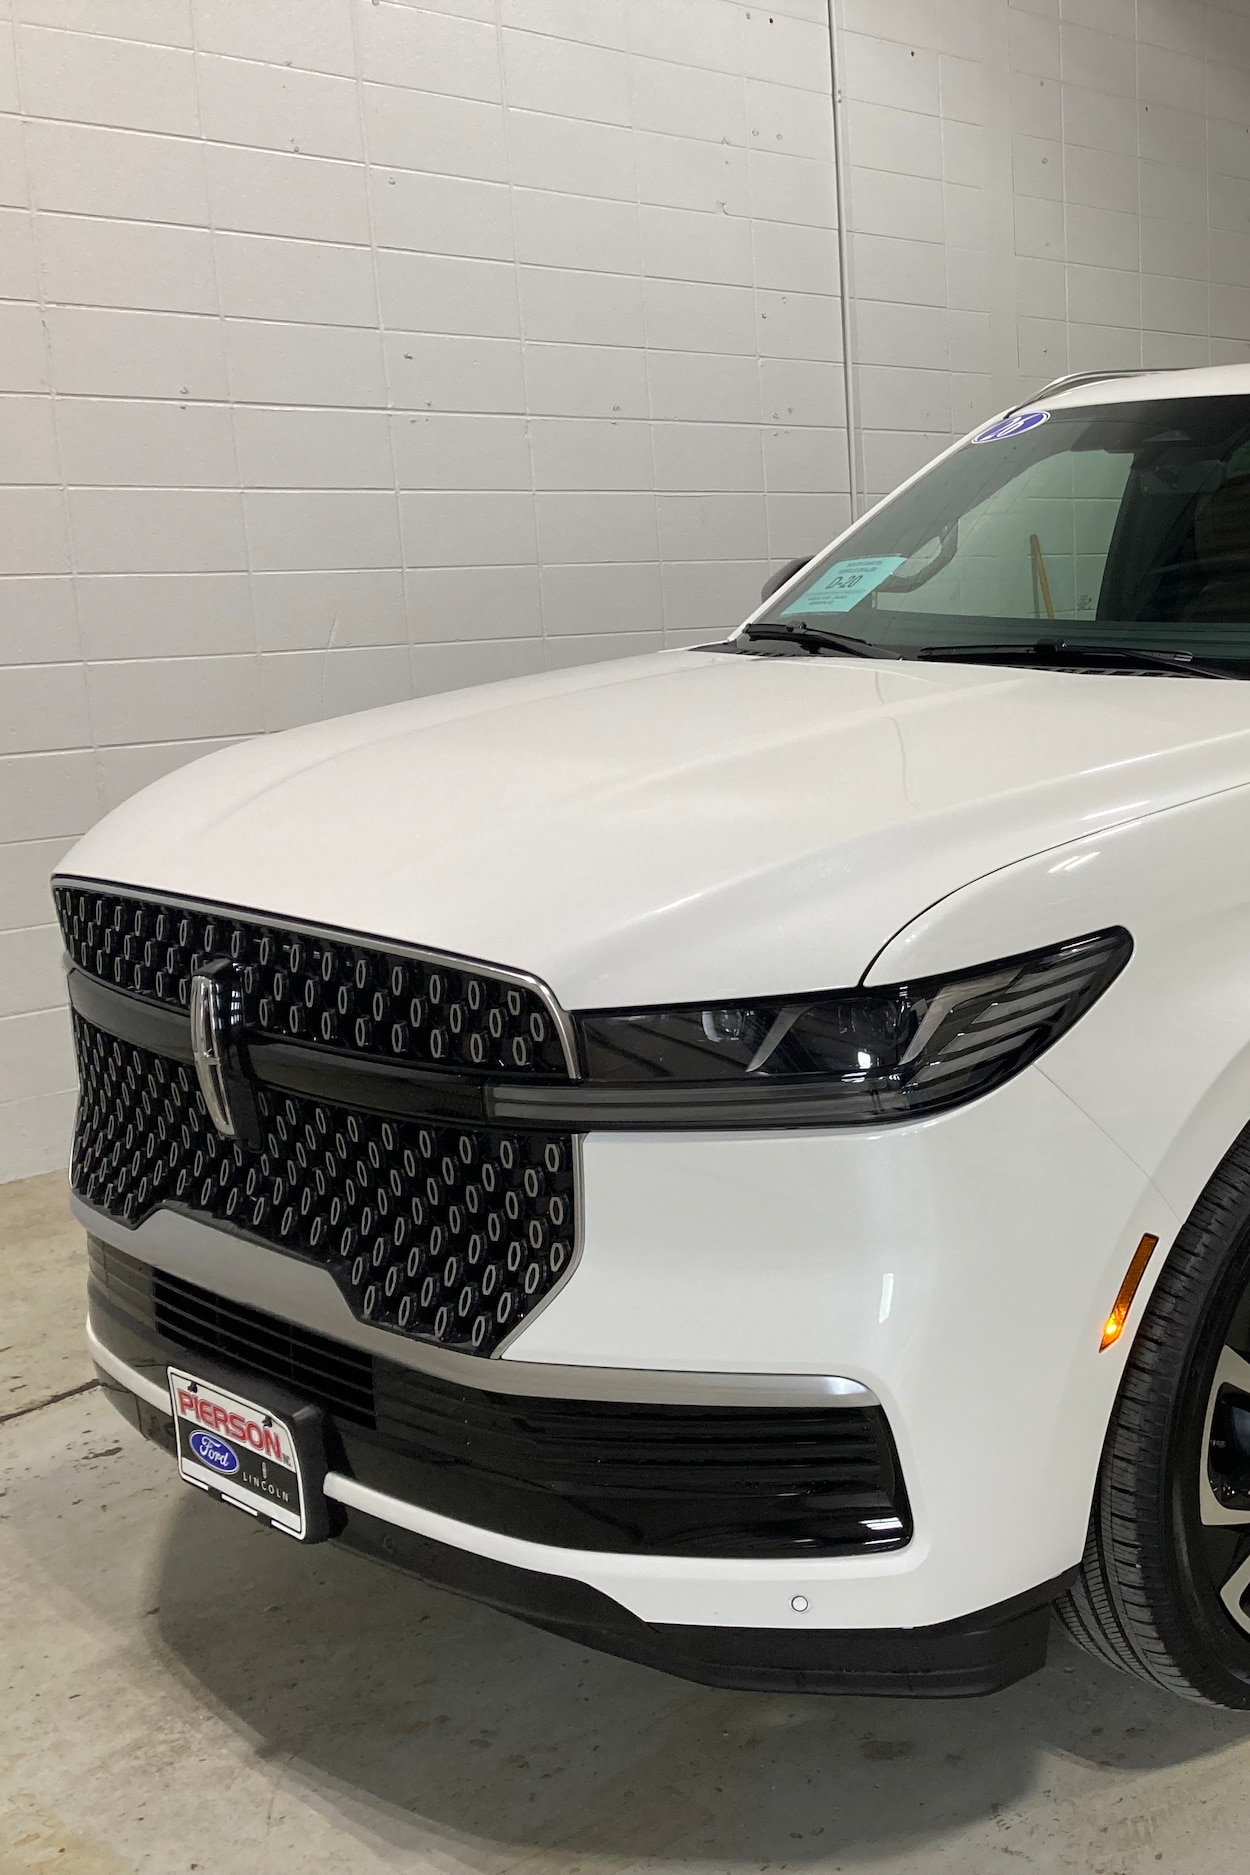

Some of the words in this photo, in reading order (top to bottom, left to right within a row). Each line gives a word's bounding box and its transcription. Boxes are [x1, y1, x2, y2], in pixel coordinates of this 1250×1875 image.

[825, 575, 863, 589] D-20
[177, 1387, 283, 1461] PIERSON
[199, 1436, 229, 1467] Ford
[242, 1471, 289, 1502] LINCOLN
